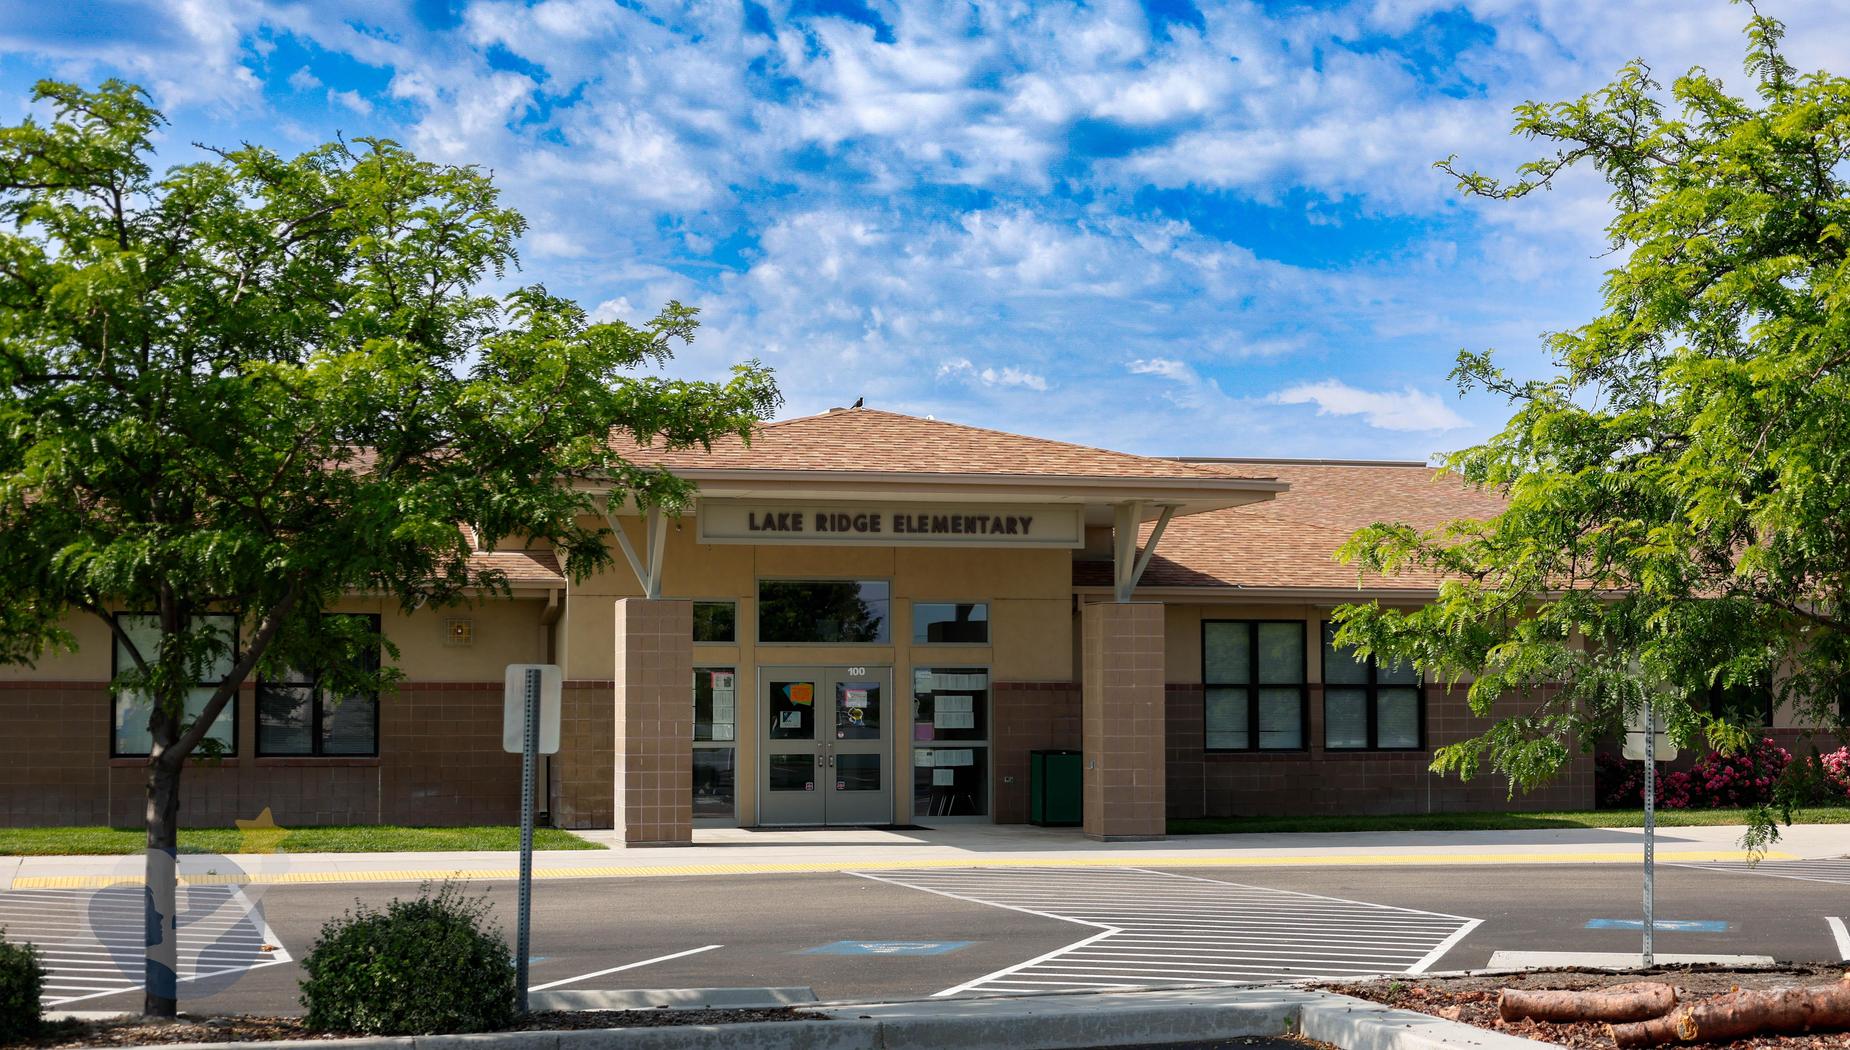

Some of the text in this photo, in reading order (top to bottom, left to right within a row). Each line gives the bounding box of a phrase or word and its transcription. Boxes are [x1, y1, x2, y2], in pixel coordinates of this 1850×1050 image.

[749, 512, 1033, 535] LAKE RIDGE ELEMENTARY
[848, 667, 865, 676] 100
